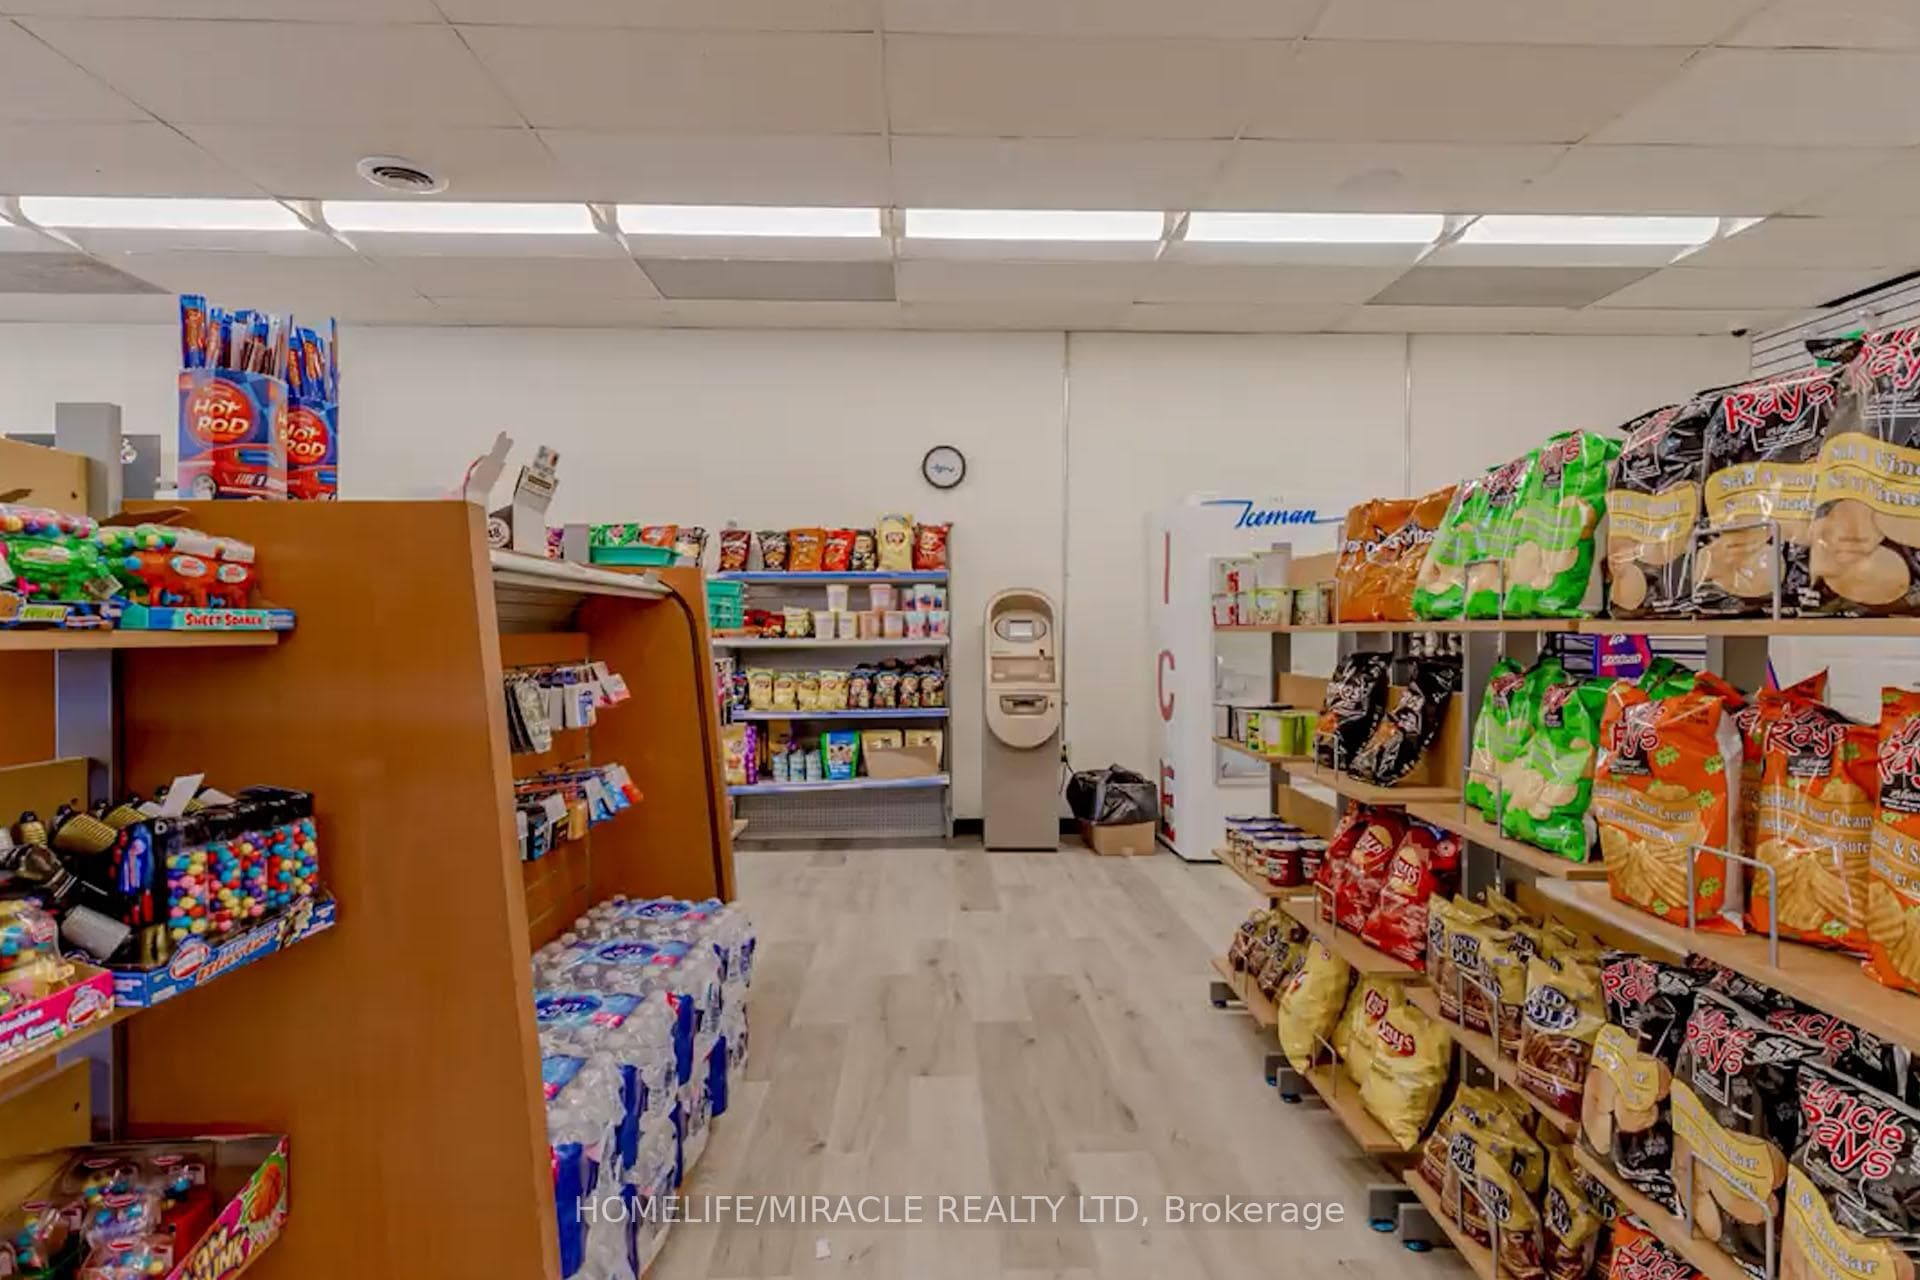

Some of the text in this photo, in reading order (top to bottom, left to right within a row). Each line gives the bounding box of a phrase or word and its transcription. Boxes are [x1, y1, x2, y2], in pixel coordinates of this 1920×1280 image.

[193, 399, 242, 415] HOT
[197, 417, 249, 434] ROD
[1201, 499, 1345, 528] Iceman
[1832, 808, 1873, 829] Cream
[1807, 1079, 1905, 1152] Uncle
[1801, 1102, 1896, 1179] Rays
[1627, 1235, 1691, 1280] Uncl
